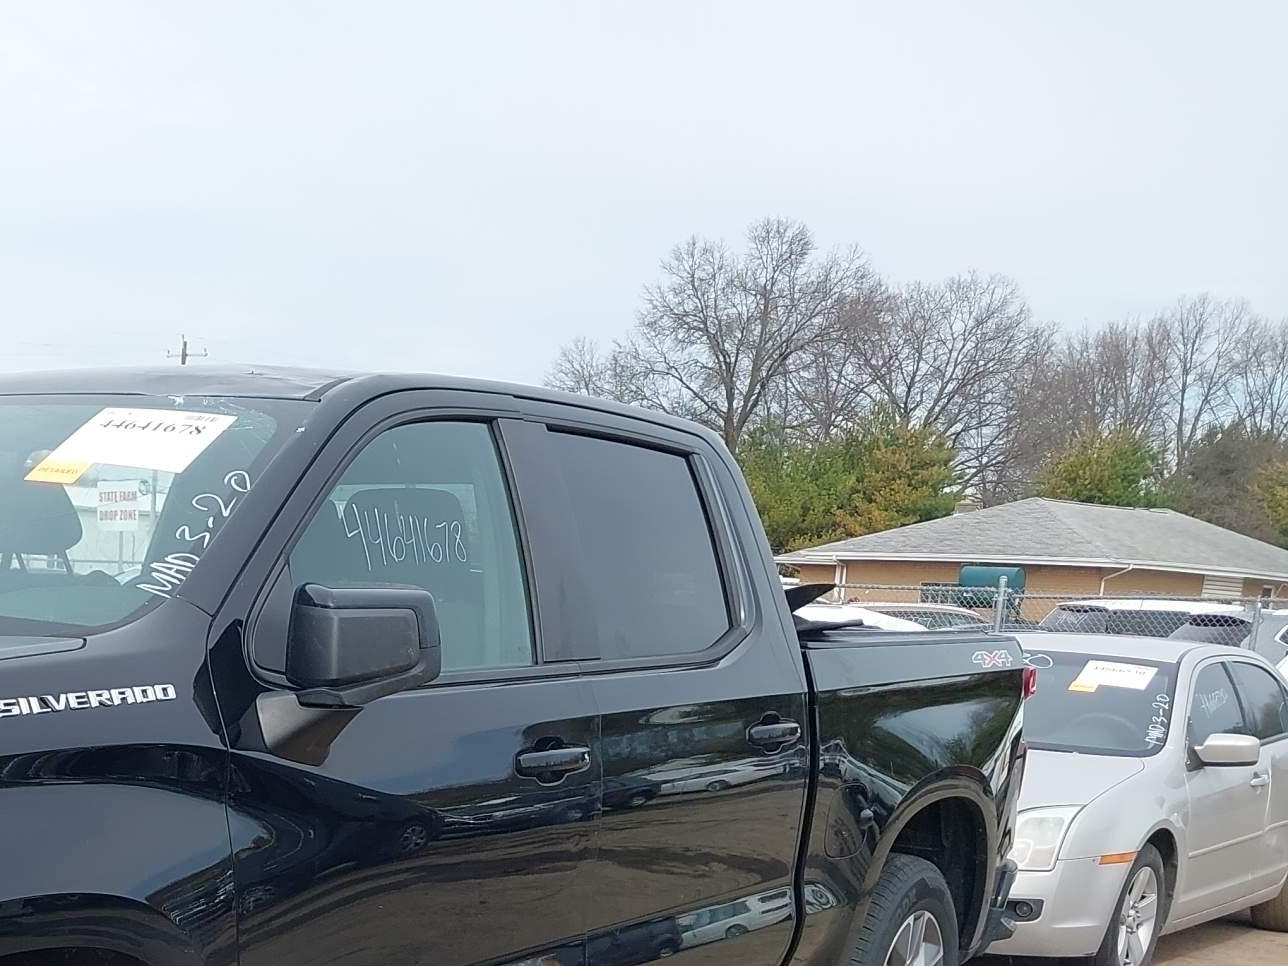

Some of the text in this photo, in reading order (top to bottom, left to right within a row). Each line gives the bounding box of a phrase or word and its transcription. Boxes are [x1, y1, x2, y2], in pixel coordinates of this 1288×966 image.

[99, 418, 207, 436] 44641678
[99, 491, 118, 503] STATE
[99, 510, 137, 521] DROP ZONE
[340, 503, 468, 572] 44641678
[135, 552, 200, 599] MAD
